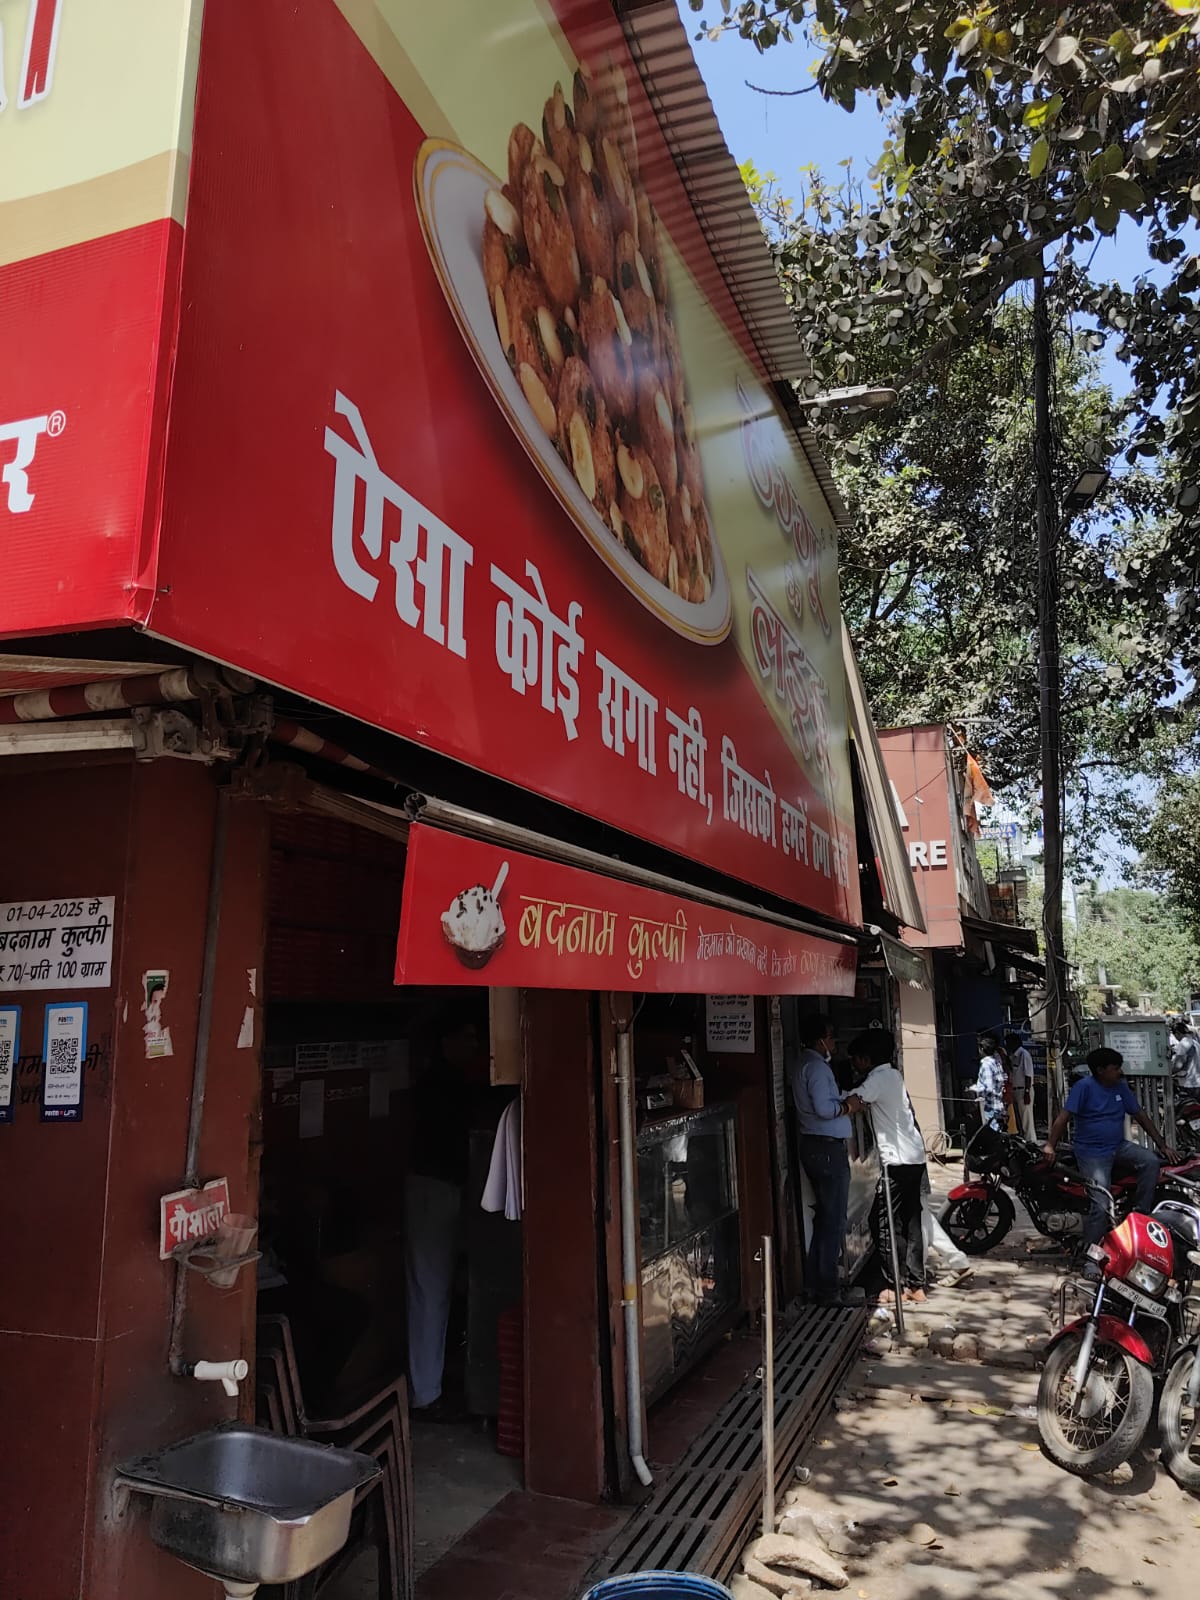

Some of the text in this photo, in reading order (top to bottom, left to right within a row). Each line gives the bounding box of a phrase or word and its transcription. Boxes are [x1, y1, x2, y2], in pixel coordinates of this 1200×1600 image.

[324, 389, 474, 660] ऐसा
[490, 559, 585, 742] कोई
[596, 650, 658, 776] सगा
[721, 735, 776, 848] जिसको
[6, 898, 102, 922] 01-04-2025 से
[0, 915, 112, 957] बदनाम कुल्फी
[519, 895, 688, 979] बदनाम कुल्फी
[57, 961, 78, 979] 100
[80, 961, 107, 978] ग्राम
